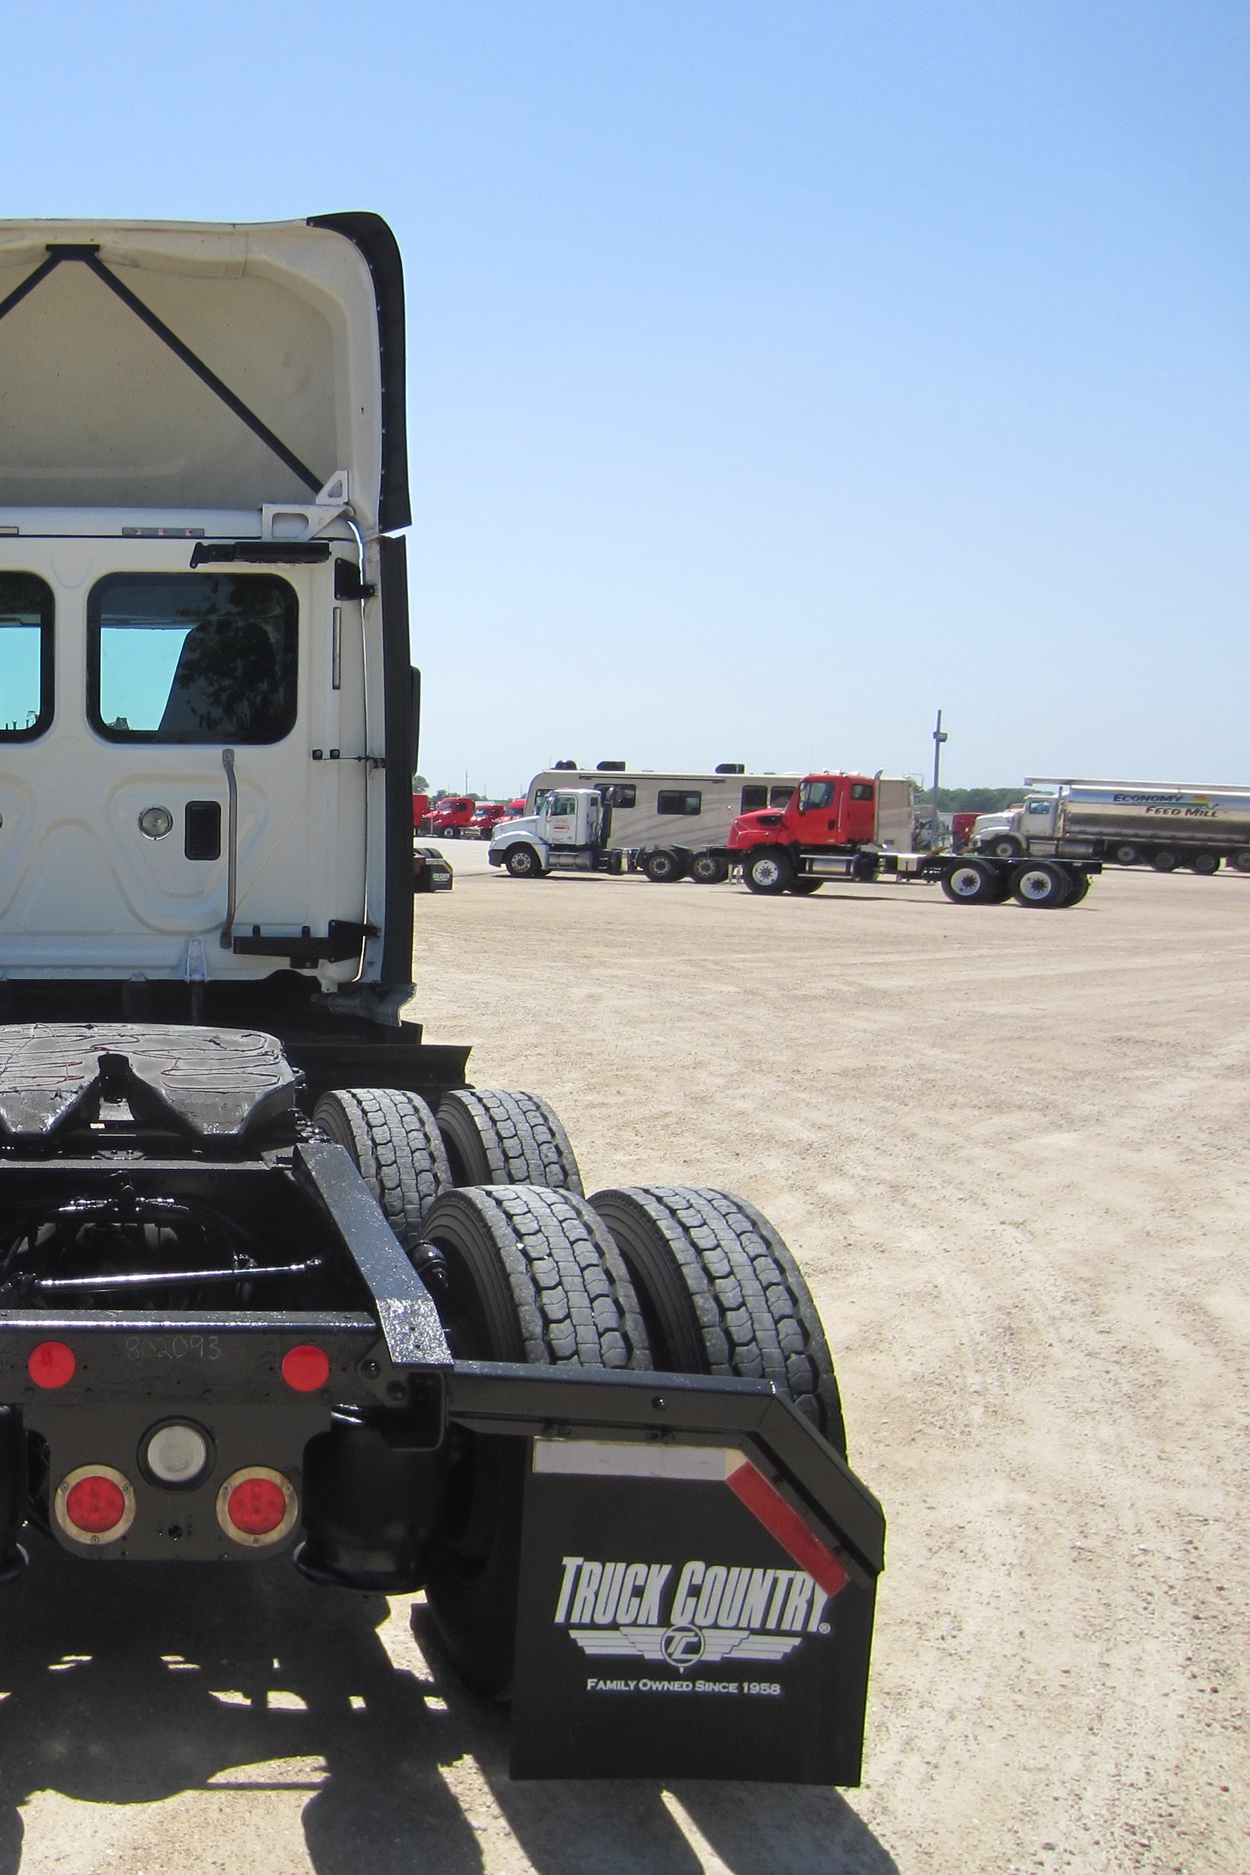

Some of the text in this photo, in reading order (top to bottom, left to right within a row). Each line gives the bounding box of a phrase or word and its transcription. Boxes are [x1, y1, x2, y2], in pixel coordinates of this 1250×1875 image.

[1113, 793, 1183, 803] ECONOMY
[1145, 806, 1219, 818] FEED MILL
[554, 1556, 672, 1626] TRUCK
[586, 1678, 781, 1695] FAMILY OWNED SINCE 1958
